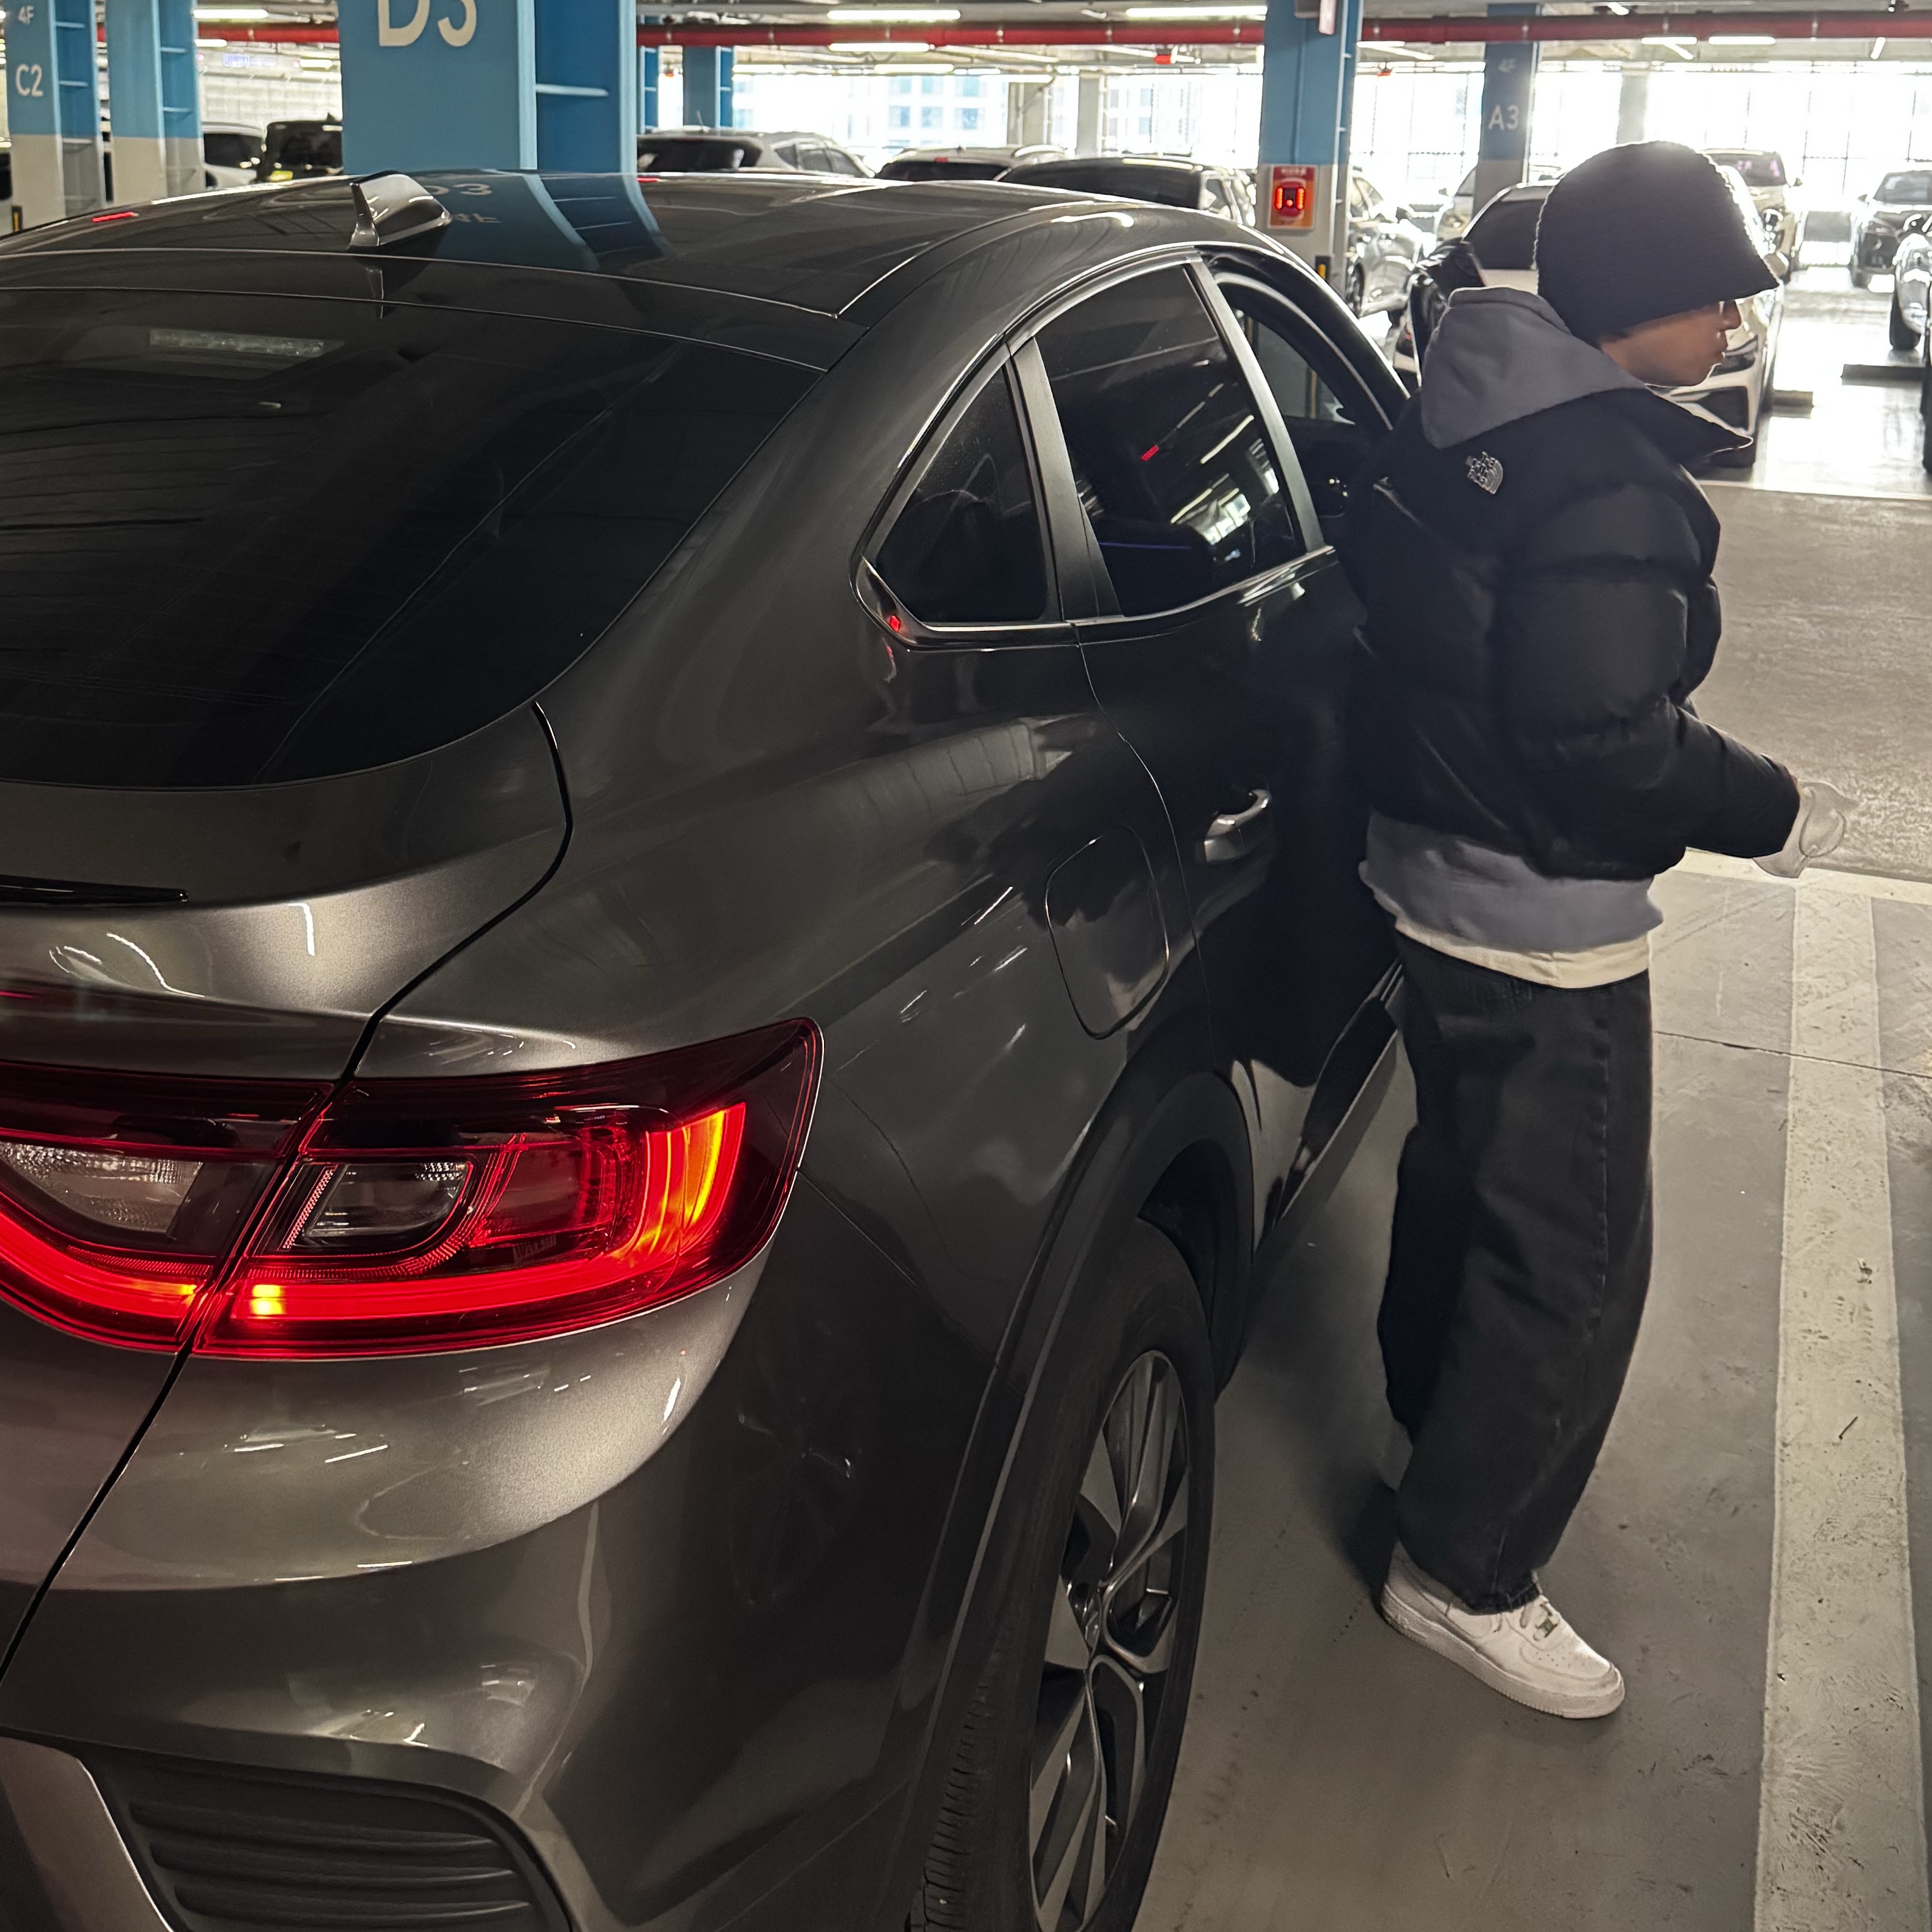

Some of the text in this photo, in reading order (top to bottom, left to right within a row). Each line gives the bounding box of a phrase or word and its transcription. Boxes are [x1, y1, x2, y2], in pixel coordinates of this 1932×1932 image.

[18, 6, 34, 24] 4F
[16, 63, 43, 97] C2
[1488, 104, 1519, 130] A3
